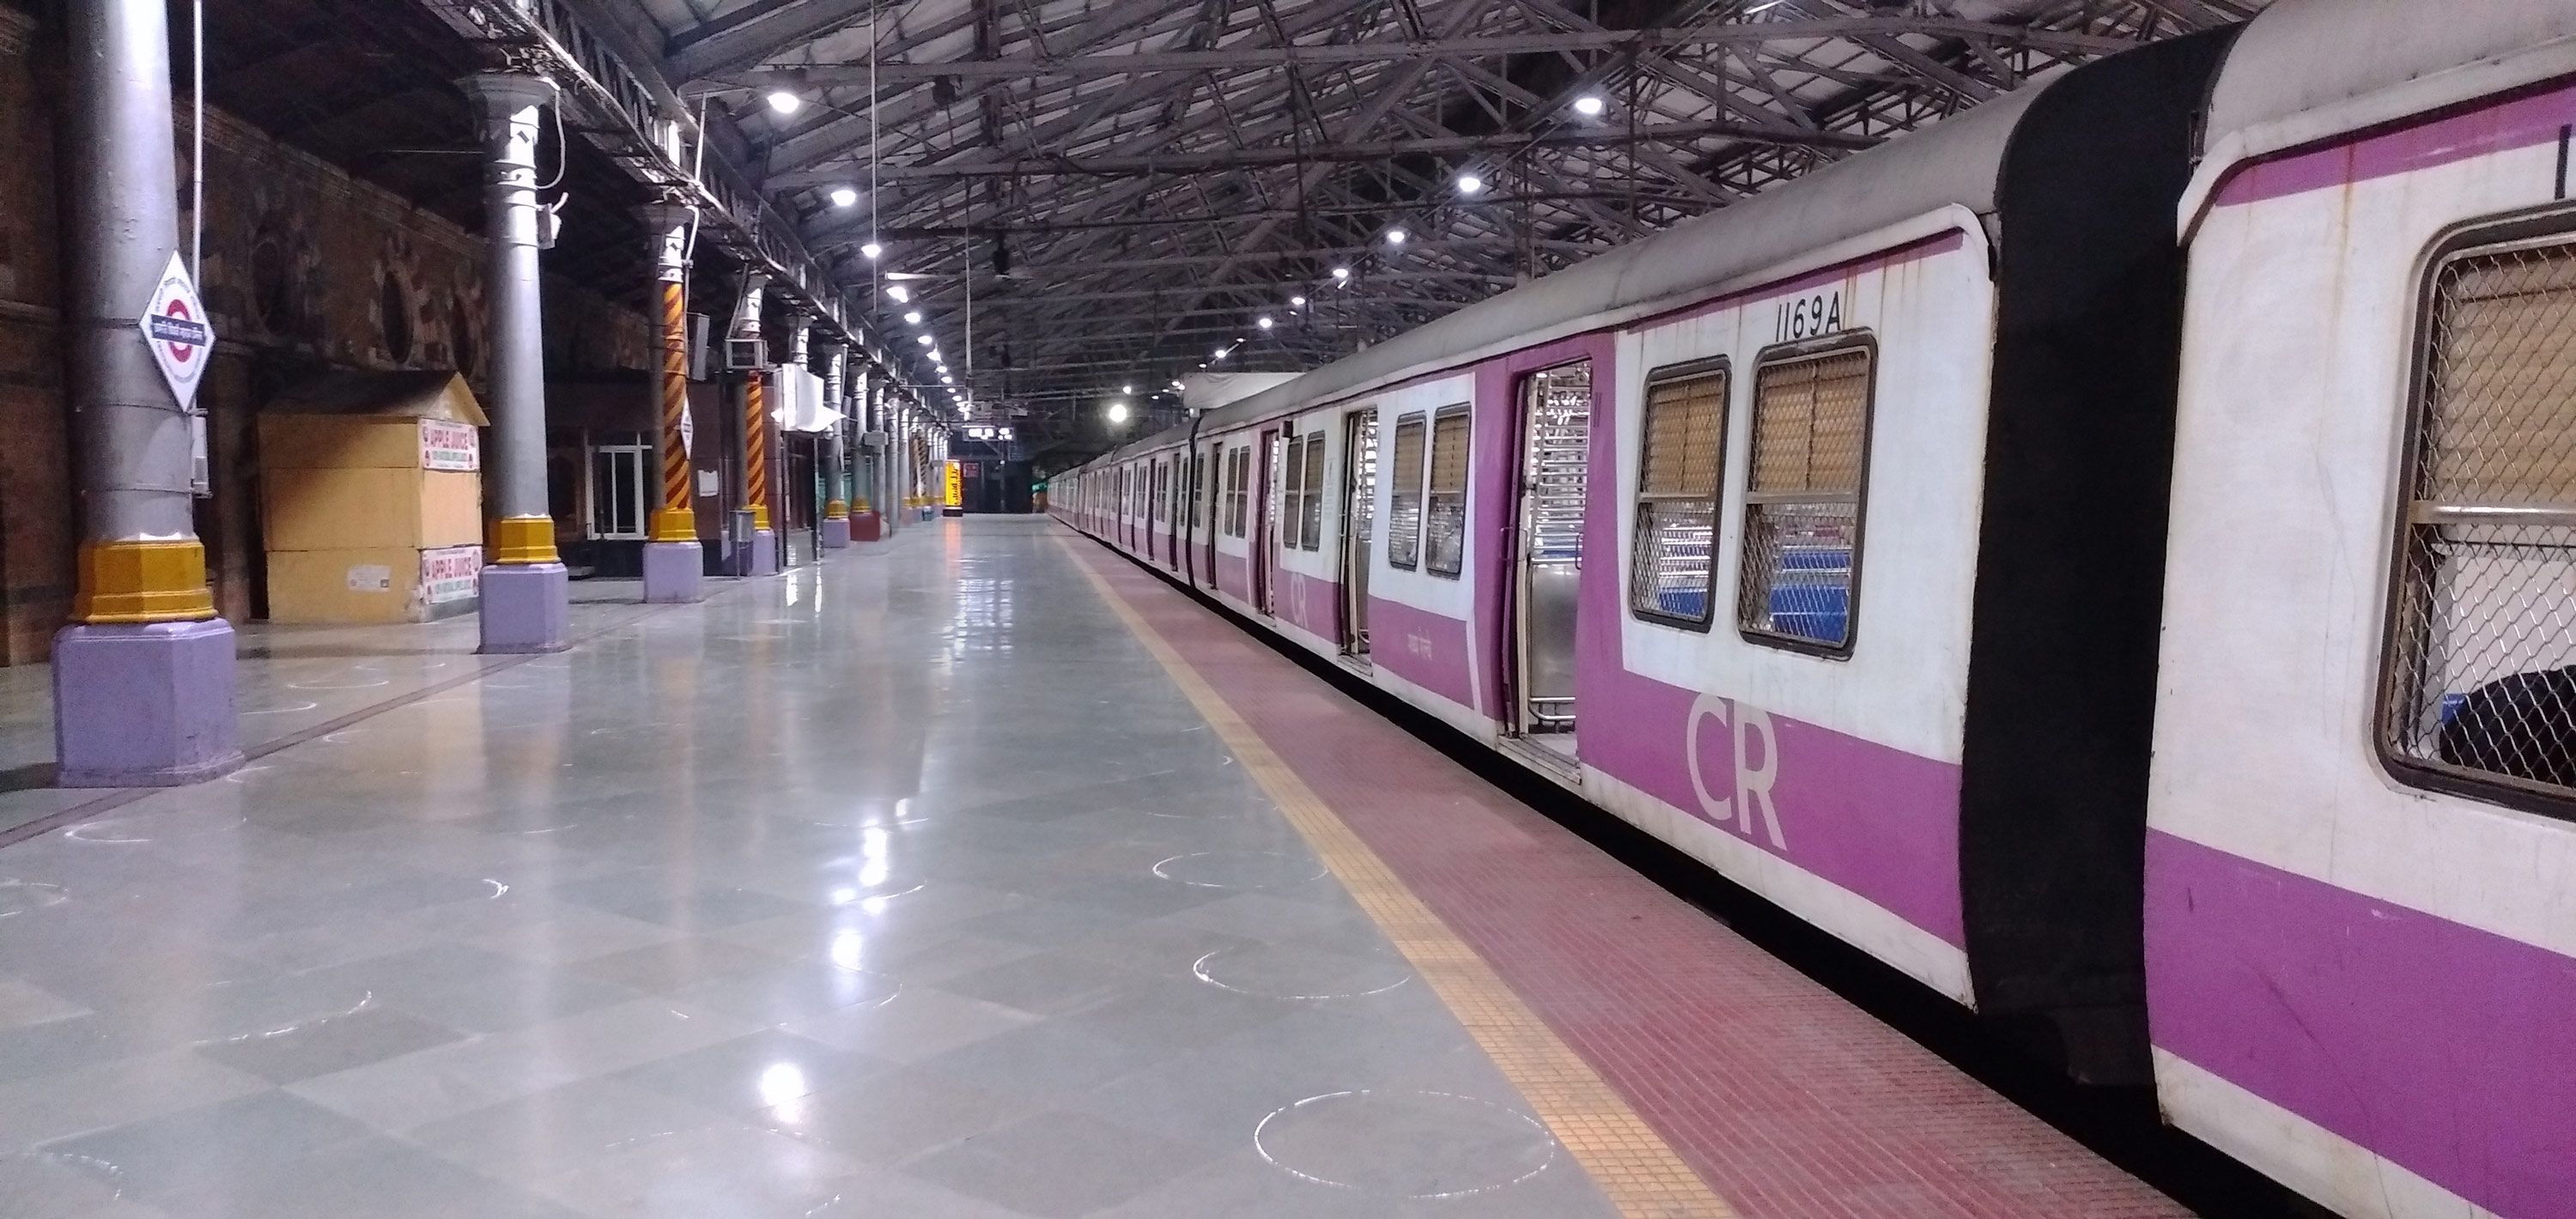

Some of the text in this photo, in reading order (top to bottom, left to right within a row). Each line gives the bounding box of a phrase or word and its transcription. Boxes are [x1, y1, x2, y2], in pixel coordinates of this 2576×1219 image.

[1776, 291, 1841, 343] 1169A
[431, 429, 449, 448] APPLE
[432, 559, 452, 579] APPLE
[1291, 573, 1309, 629] CR
[1686, 692, 1787, 851] CR
